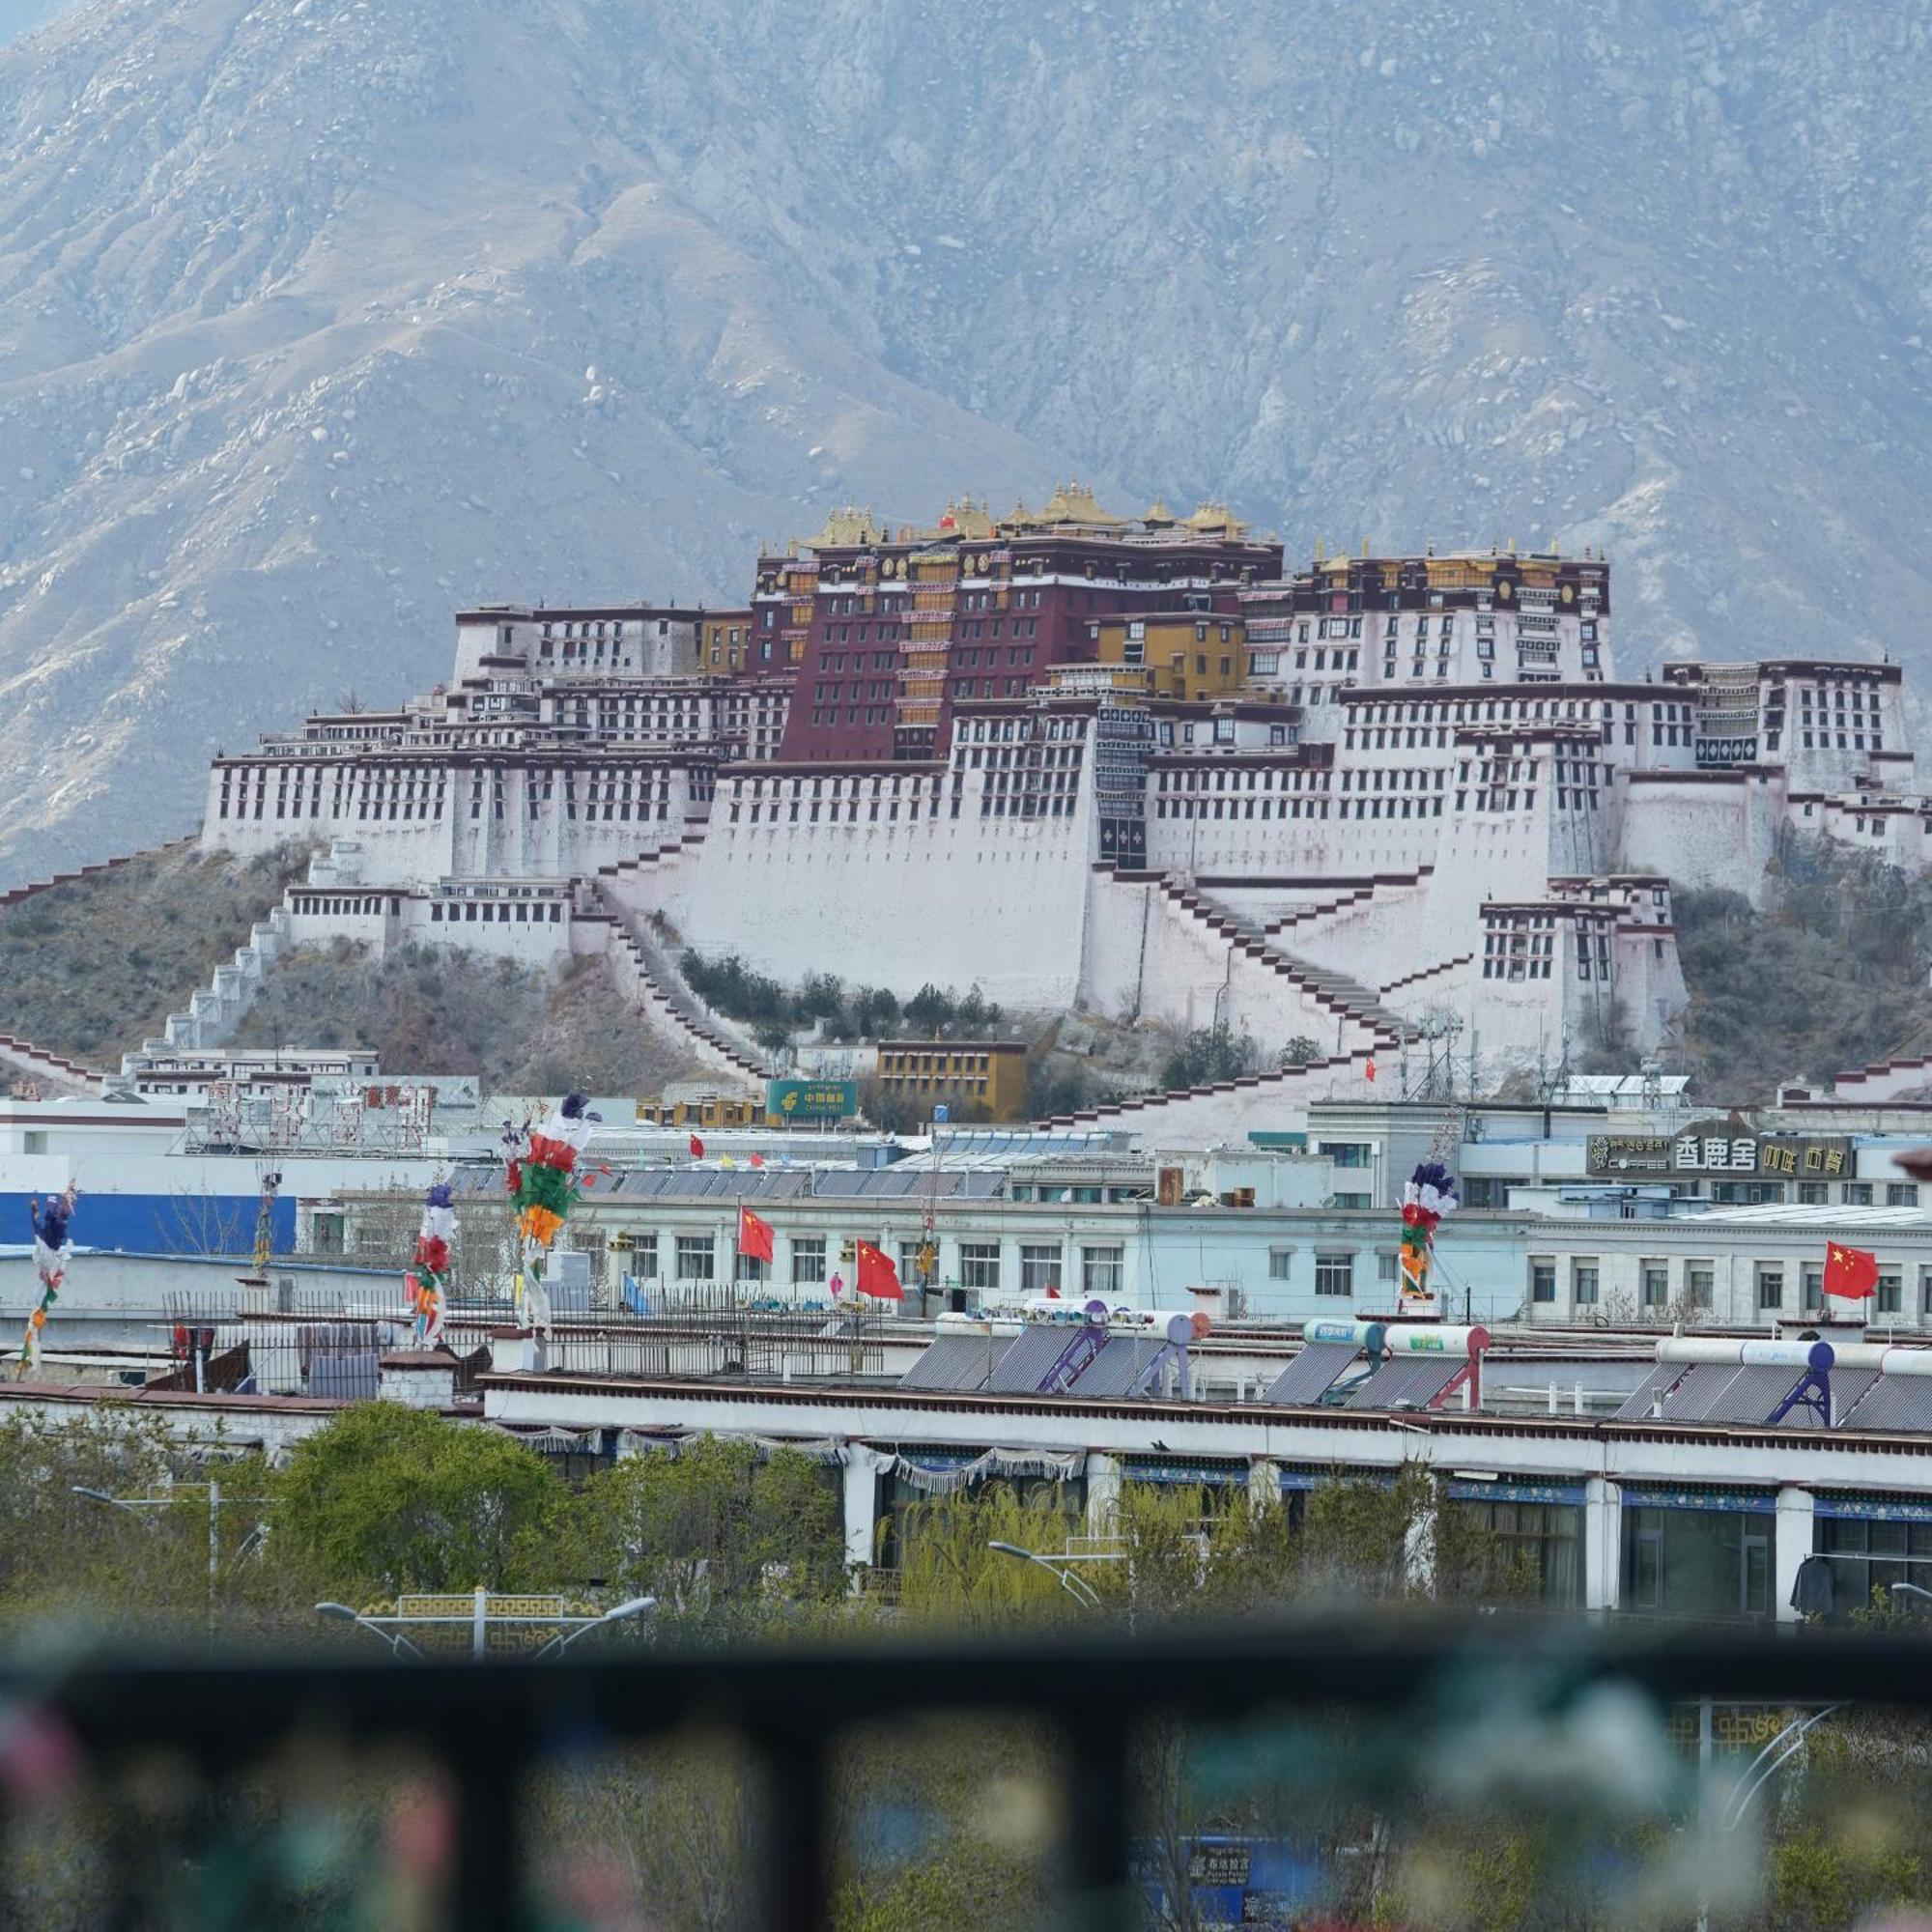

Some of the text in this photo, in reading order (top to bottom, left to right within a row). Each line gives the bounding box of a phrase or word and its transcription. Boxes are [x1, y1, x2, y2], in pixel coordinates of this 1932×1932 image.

[1607, 1158, 1668, 1170] COFFEE
[1676, 1135, 1756, 1171] 香鹿舍
